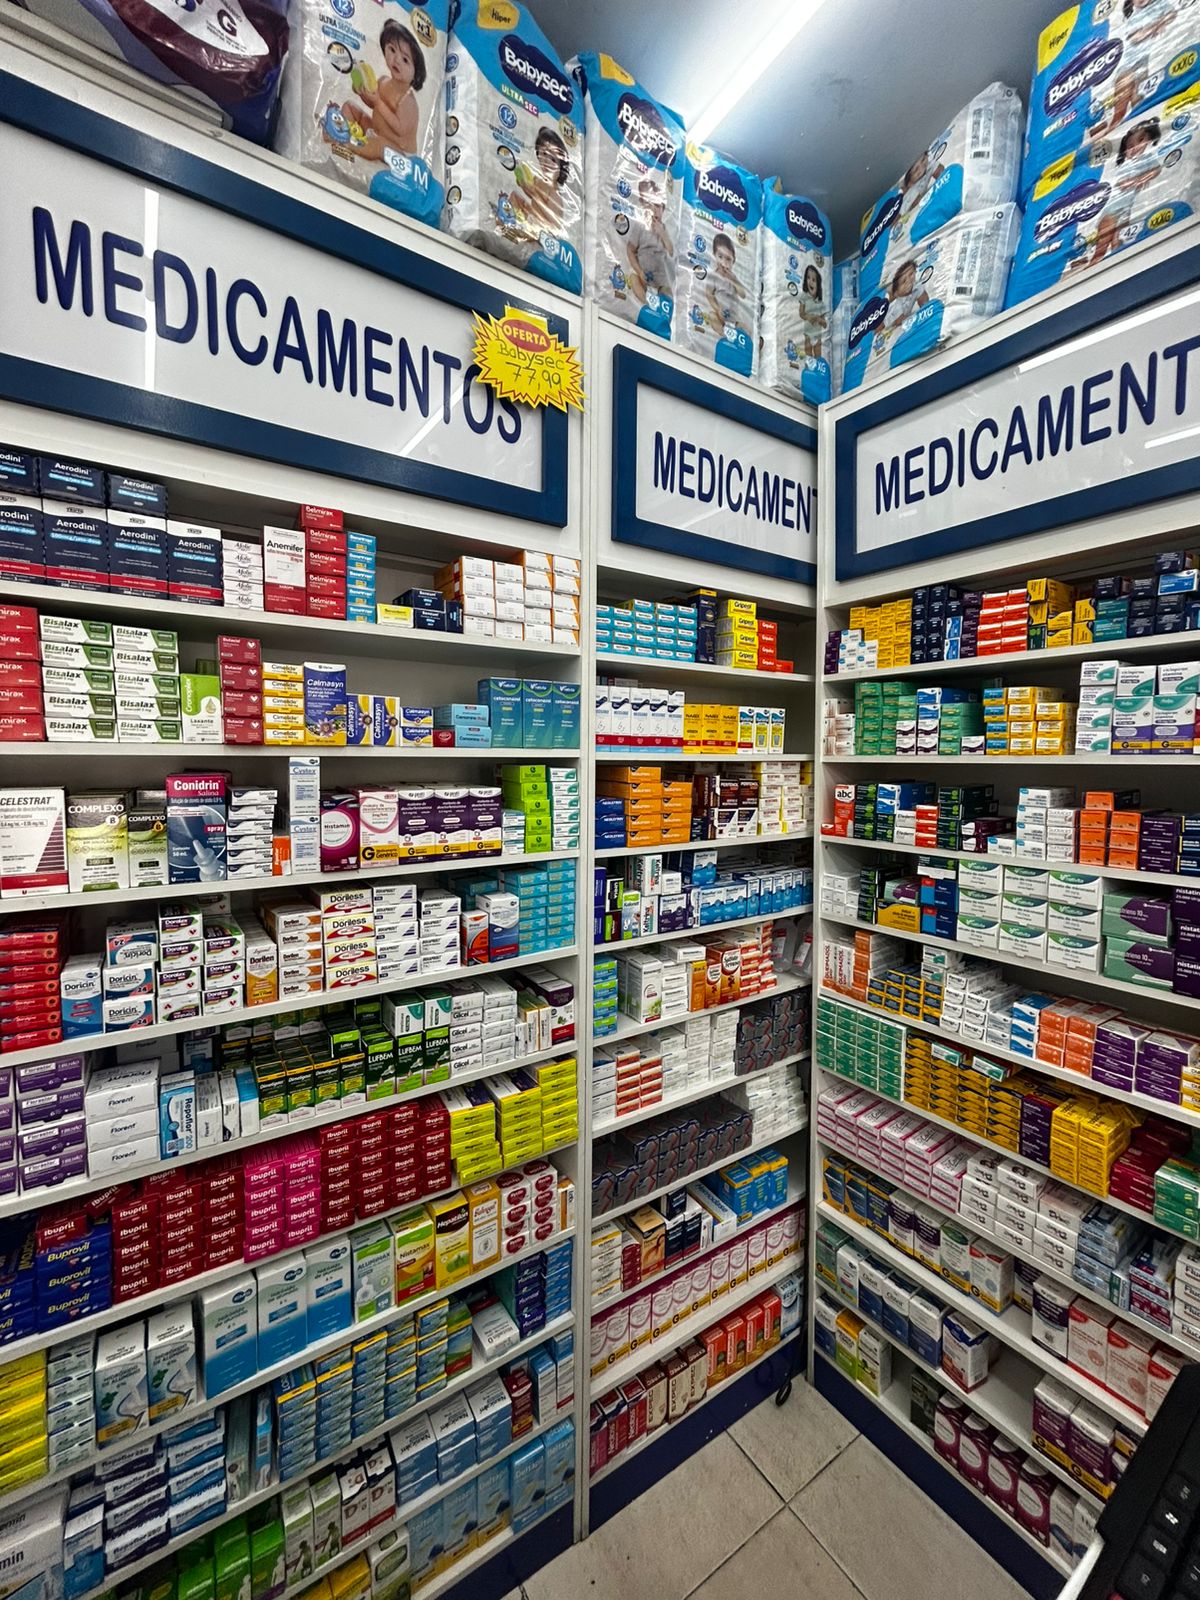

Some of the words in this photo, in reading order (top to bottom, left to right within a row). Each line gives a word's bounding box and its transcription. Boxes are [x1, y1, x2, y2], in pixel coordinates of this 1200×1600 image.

[319, 14, 338, 28] ULTRA
[491, 8, 512, 24] Hiper
[217, 9, 237, 36] G
[1049, 28, 1069, 49] Hiper
[504, 46, 571, 102] Babysec
[1048, 46, 1117, 104] Babysec
[501, 84, 524, 103] ULTRA
[524, 102, 539, 115] SEC
[620, 103, 675, 154] Babysec
[391, 155, 406, 171] 68
[414, 165, 428, 190] M
[1050, 165, 1069, 181] Hiper
[699, 173, 745, 211] Babysec
[1038, 193, 1104, 232] Babysec
[789, 210, 823, 239] Babysec
[863, 200, 901, 250] Babysec
[1124, 225, 1138, 237] 42
[560, 246, 573, 266] M
[662, 300, 670, 312] G
[917, 304, 934, 323] XXG
[33, 206, 521, 443] MEDICAMENTOS
[850, 304, 886, 341] Babysec
[503, 324, 547, 346] OFERTA
[738, 335, 746, 346] G
[497, 343, 565, 371] Babysec
[817, 360, 826, 373] XG
[505, 363, 562, 390] 77,99
[876, 335, 1199, 515] MEDICAMENT
[55, 462, 89, 475] Aerodini
[123, 479, 155, 491] Aerodini
[653, 431, 817, 533] MEDICAMEN
[56, 519, 96, 532] Aerodini
[120, 529, 156, 541] Aerodini
[178, 539, 212, 551] Aerodini
[267, 539, 304, 553] Anemifer
[44, 618, 79, 628] Bisalax
[117, 628, 149, 637] Bisalax
[45, 644, 80, 654] Bisalax
[117, 653, 151, 662] Bisalax
[46, 670, 81, 679] Bisalax
[118, 674, 150, 683] Bisalax
[307, 679, 344, 690] Calmasyn
[49, 697, 88, 706] Bisalax
[120, 700, 155, 708] Bisalax
[50, 722, 88, 730] Bisalax
[375, 703, 383, 739] Calmasyn
[293, 767, 316, 775] Cystex
[173, 780, 220, 791] Conidrin
[837, 790, 852, 799] abc
[68, 804, 125, 813] COMPLEXO
[206, 825, 224, 833] spray
[294, 825, 317, 833] Cystex
[408, 847, 416, 855] G
[477, 842, 484, 850] G
[361, 846, 376, 861] G
[330, 894, 364, 903] Doriless
[332, 917, 367, 929] Doriless
[124, 949, 152, 957] Doricin
[334, 942, 368, 953] Doriless
[250, 955, 274, 964] Dorilen
[336, 966, 370, 978] Doriless
[109, 975, 137, 984] Doricin
[65, 982, 94, 991] Doricin
[109, 1007, 137, 1016] Doricin
[452, 1027, 468, 1036] Glicel
[426, 1039, 449, 1048] LUFBEM
[452, 1044, 468, 1053] Glicel
[398, 1046, 422, 1056] LUFBEM
[368, 1053, 394, 1063] LUFBEM
[454, 1060, 470, 1069] Glicel
[108, 1096, 134, 1106] Florent
[184, 1097, 193, 1133] Repoflor
[110, 1123, 136, 1133] Florent
[112, 1151, 137, 1161] Florent
[290, 1158, 314, 1169] Ibupril
[210, 1175, 235, 1187] Ibupril
[251, 1169, 277, 1182] Ibupril
[91, 1186, 118, 1206] Ibupril
[166, 1188, 192, 1201] Ibupril
[251, 1187, 277, 1200] Ibupril
[290, 1192, 315, 1204] Ibupril
[120, 1204, 148, 1218] Ibupril
[166, 1207, 193, 1221] Ibupril
[212, 1210, 236, 1222] Ibupril
[251, 1204, 277, 1217] Ibupril
[291, 1208, 315, 1221] Ibupril
[44, 1221, 75, 1237] Ibupril
[120, 1222, 148, 1236] Ibupril
[47, 1241, 90, 1262] Buprovil
[122, 1240, 149, 1255] Ibupril
[49, 1267, 91, 1287] Buprovil
[120, 1277, 148, 1292] Ibupril
[48, 1293, 90, 1313] Buprovil
